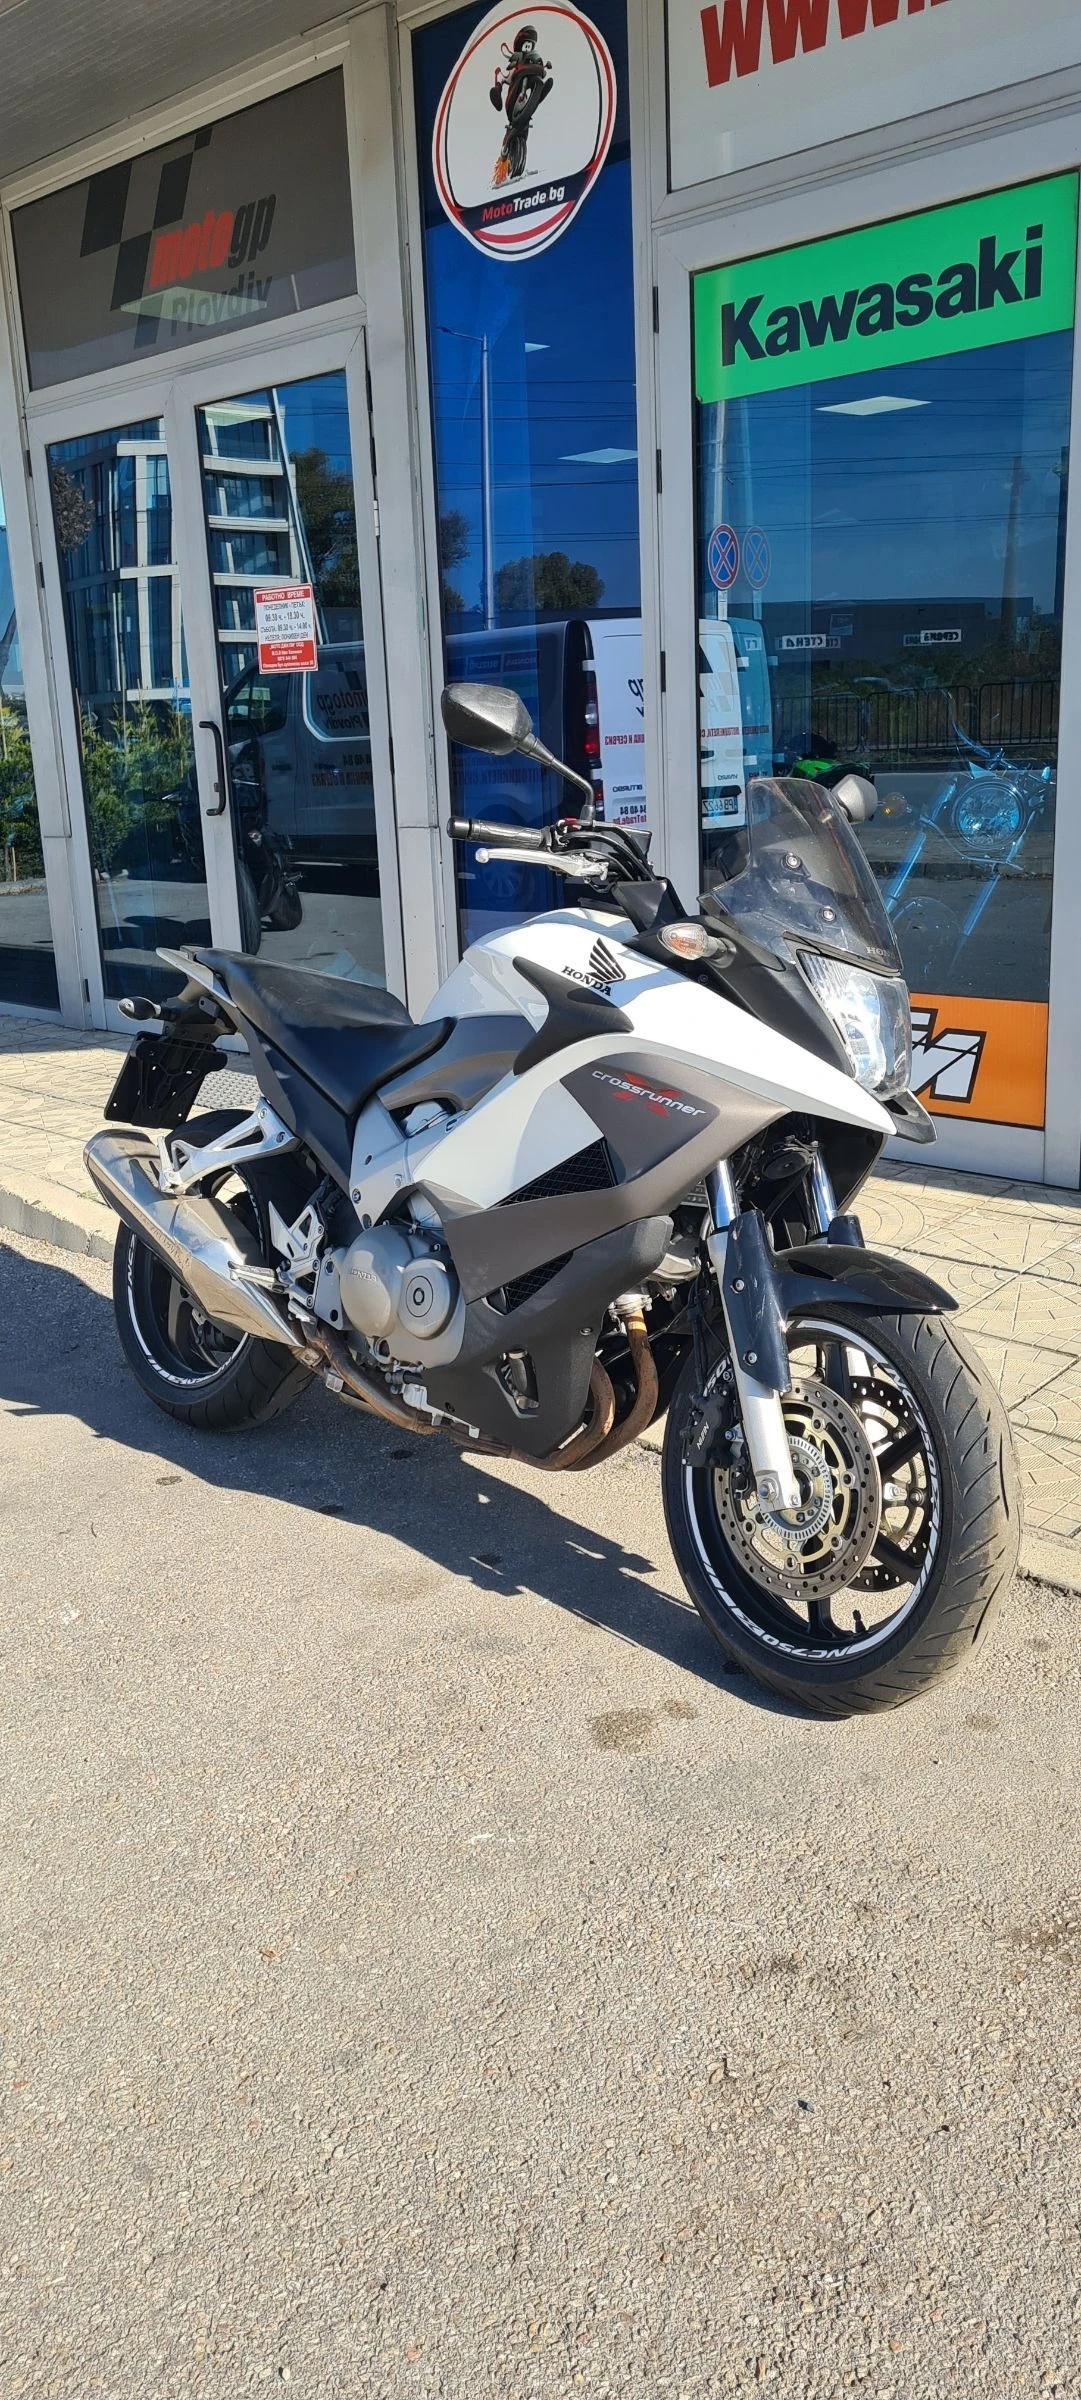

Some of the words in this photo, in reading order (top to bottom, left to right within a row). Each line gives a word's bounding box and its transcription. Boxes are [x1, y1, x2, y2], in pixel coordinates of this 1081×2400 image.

[482, 186, 566, 222] MotoTrade.bg
[170, 271, 273, 336] Plovdiv
[721, 224, 1043, 367] Kawasaki
[262, 592, 285, 601] РАБОТНО
[287, 590, 304, 599] ВРЕМЕ
[561, 965, 613, 997] HONDA
[591, 1069, 707, 1117] crossrunner
